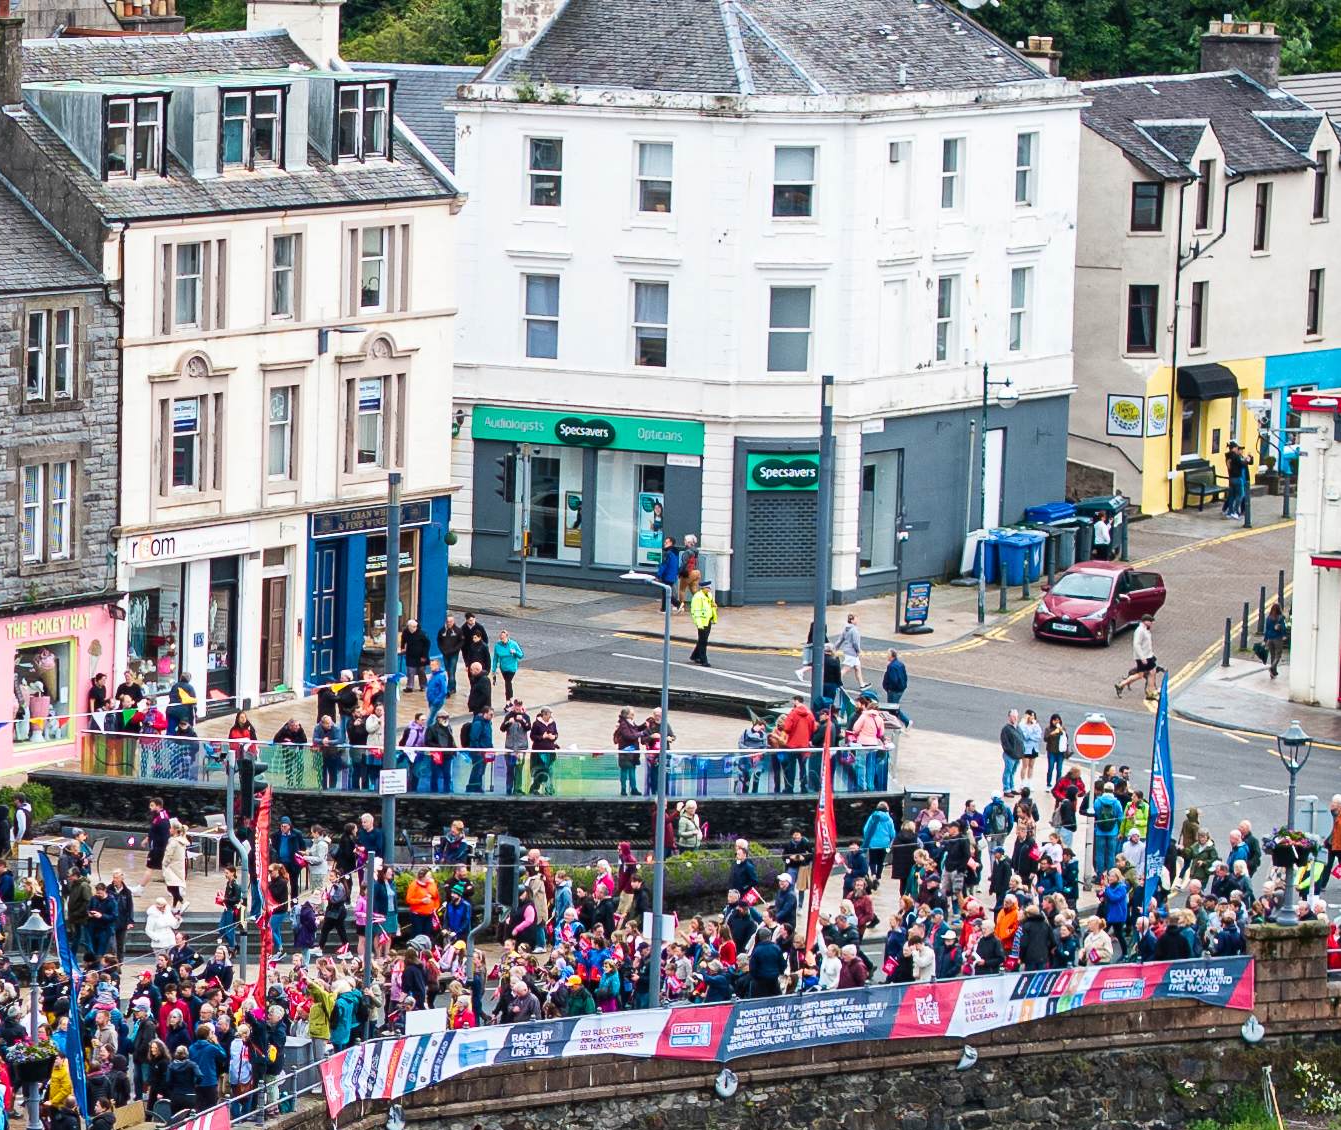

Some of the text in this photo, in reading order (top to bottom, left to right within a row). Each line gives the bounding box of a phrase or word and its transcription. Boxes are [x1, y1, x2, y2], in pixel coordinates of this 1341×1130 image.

[485, 416, 683, 443] Audiologists Specsavers Opticians
[759, 466, 816, 480] Specsavers
[7, 612, 91, 640] THE POKEY HAT
[1169, 967, 1225, 978] FOLLOW THE
[1196, 975, 1233, 985] AROUND
[1168, 984, 1219, 993] THE WORLD
[736, 1016, 757, 1026] PUNTA
[772, 1012, 789, 1022] ESTE
[841, 1002, 882, 1013] FREMANTLE
[740, 1006, 786, 1018] PORTSMOUTH
[733, 1024, 773, 1036] NEWCASTLE
[844, 1011, 863, 1020] LONG
[918, 1015, 941, 1025] LIFE
[511, 1030, 553, 1042] RACED BY
[761, 1028, 792, 1038] QINGDAO
[817, 1026, 865, 1038] PORTSMOUTH
[511, 1047, 532, 1057] LIKE
